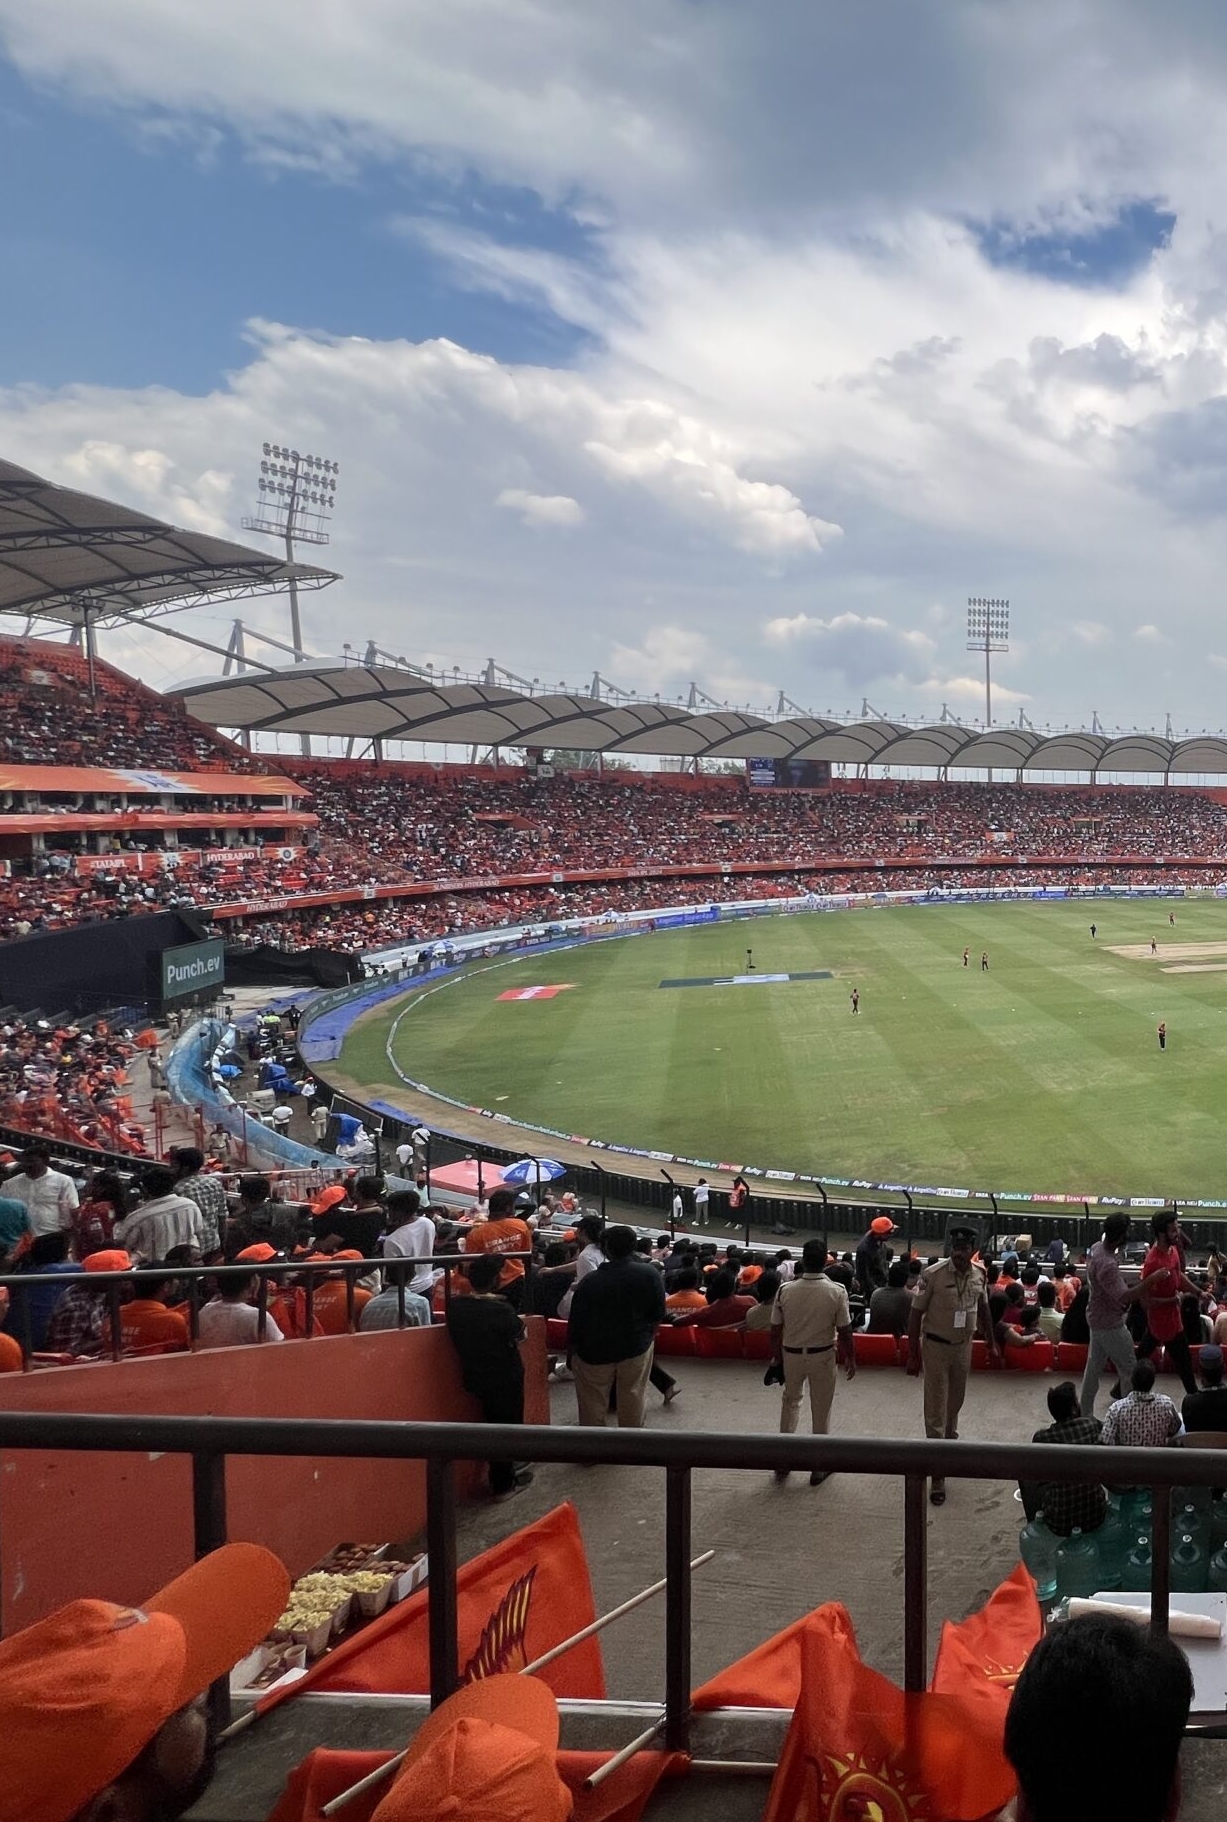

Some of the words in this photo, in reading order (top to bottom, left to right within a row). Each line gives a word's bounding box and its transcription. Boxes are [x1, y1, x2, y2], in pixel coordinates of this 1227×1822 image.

[207, 851, 255, 862] HYDERABAD
[247, 900, 288, 912] HYDERABAD
[166, 956, 220, 984] Punch.ev
[1000, 1192, 1033, 1201] Punch.ev
[1101, 1196, 1124, 1206] RuPay
